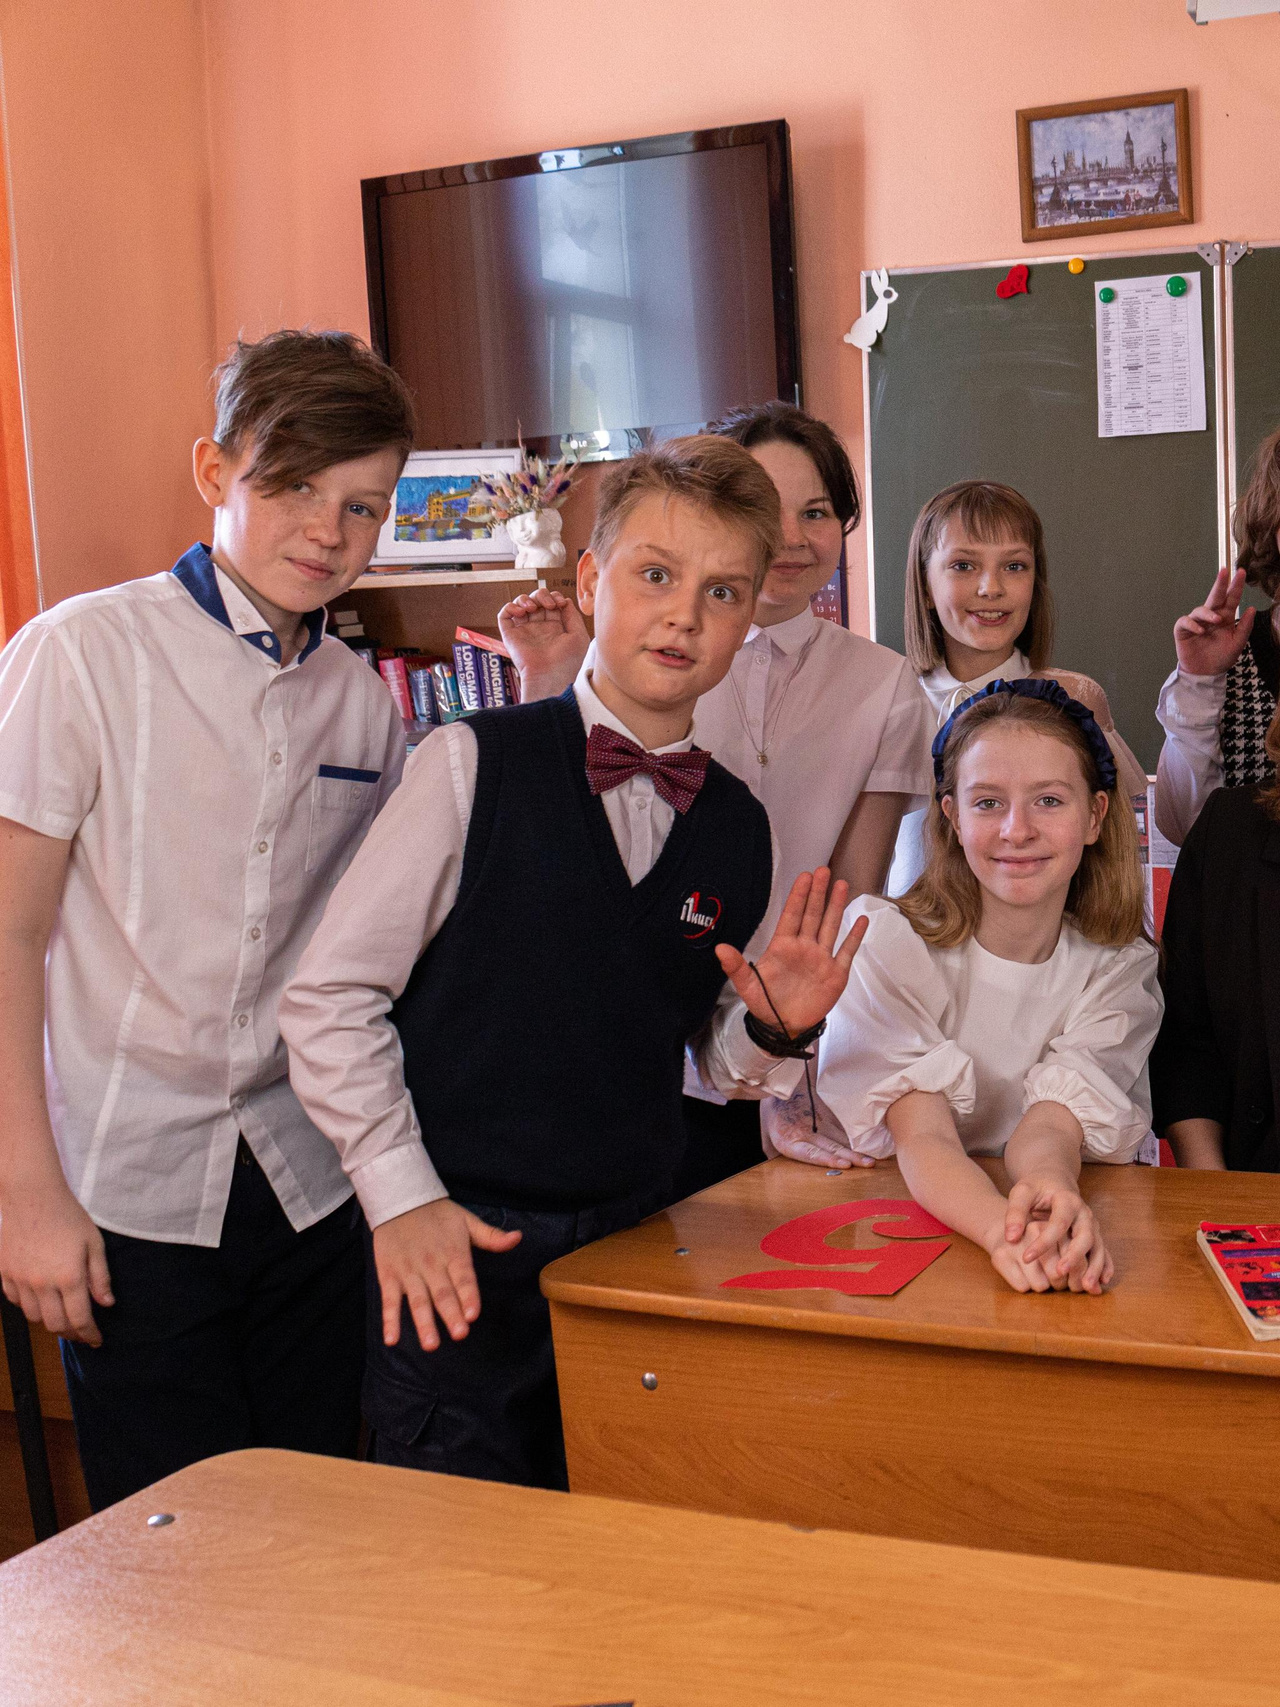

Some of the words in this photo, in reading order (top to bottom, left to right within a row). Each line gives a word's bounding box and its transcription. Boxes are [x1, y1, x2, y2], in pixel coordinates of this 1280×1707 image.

[455, 646, 466, 674] Exams
[462, 644, 479, 710] LONGMAN
[480, 653, 494, 694] Contemporary
